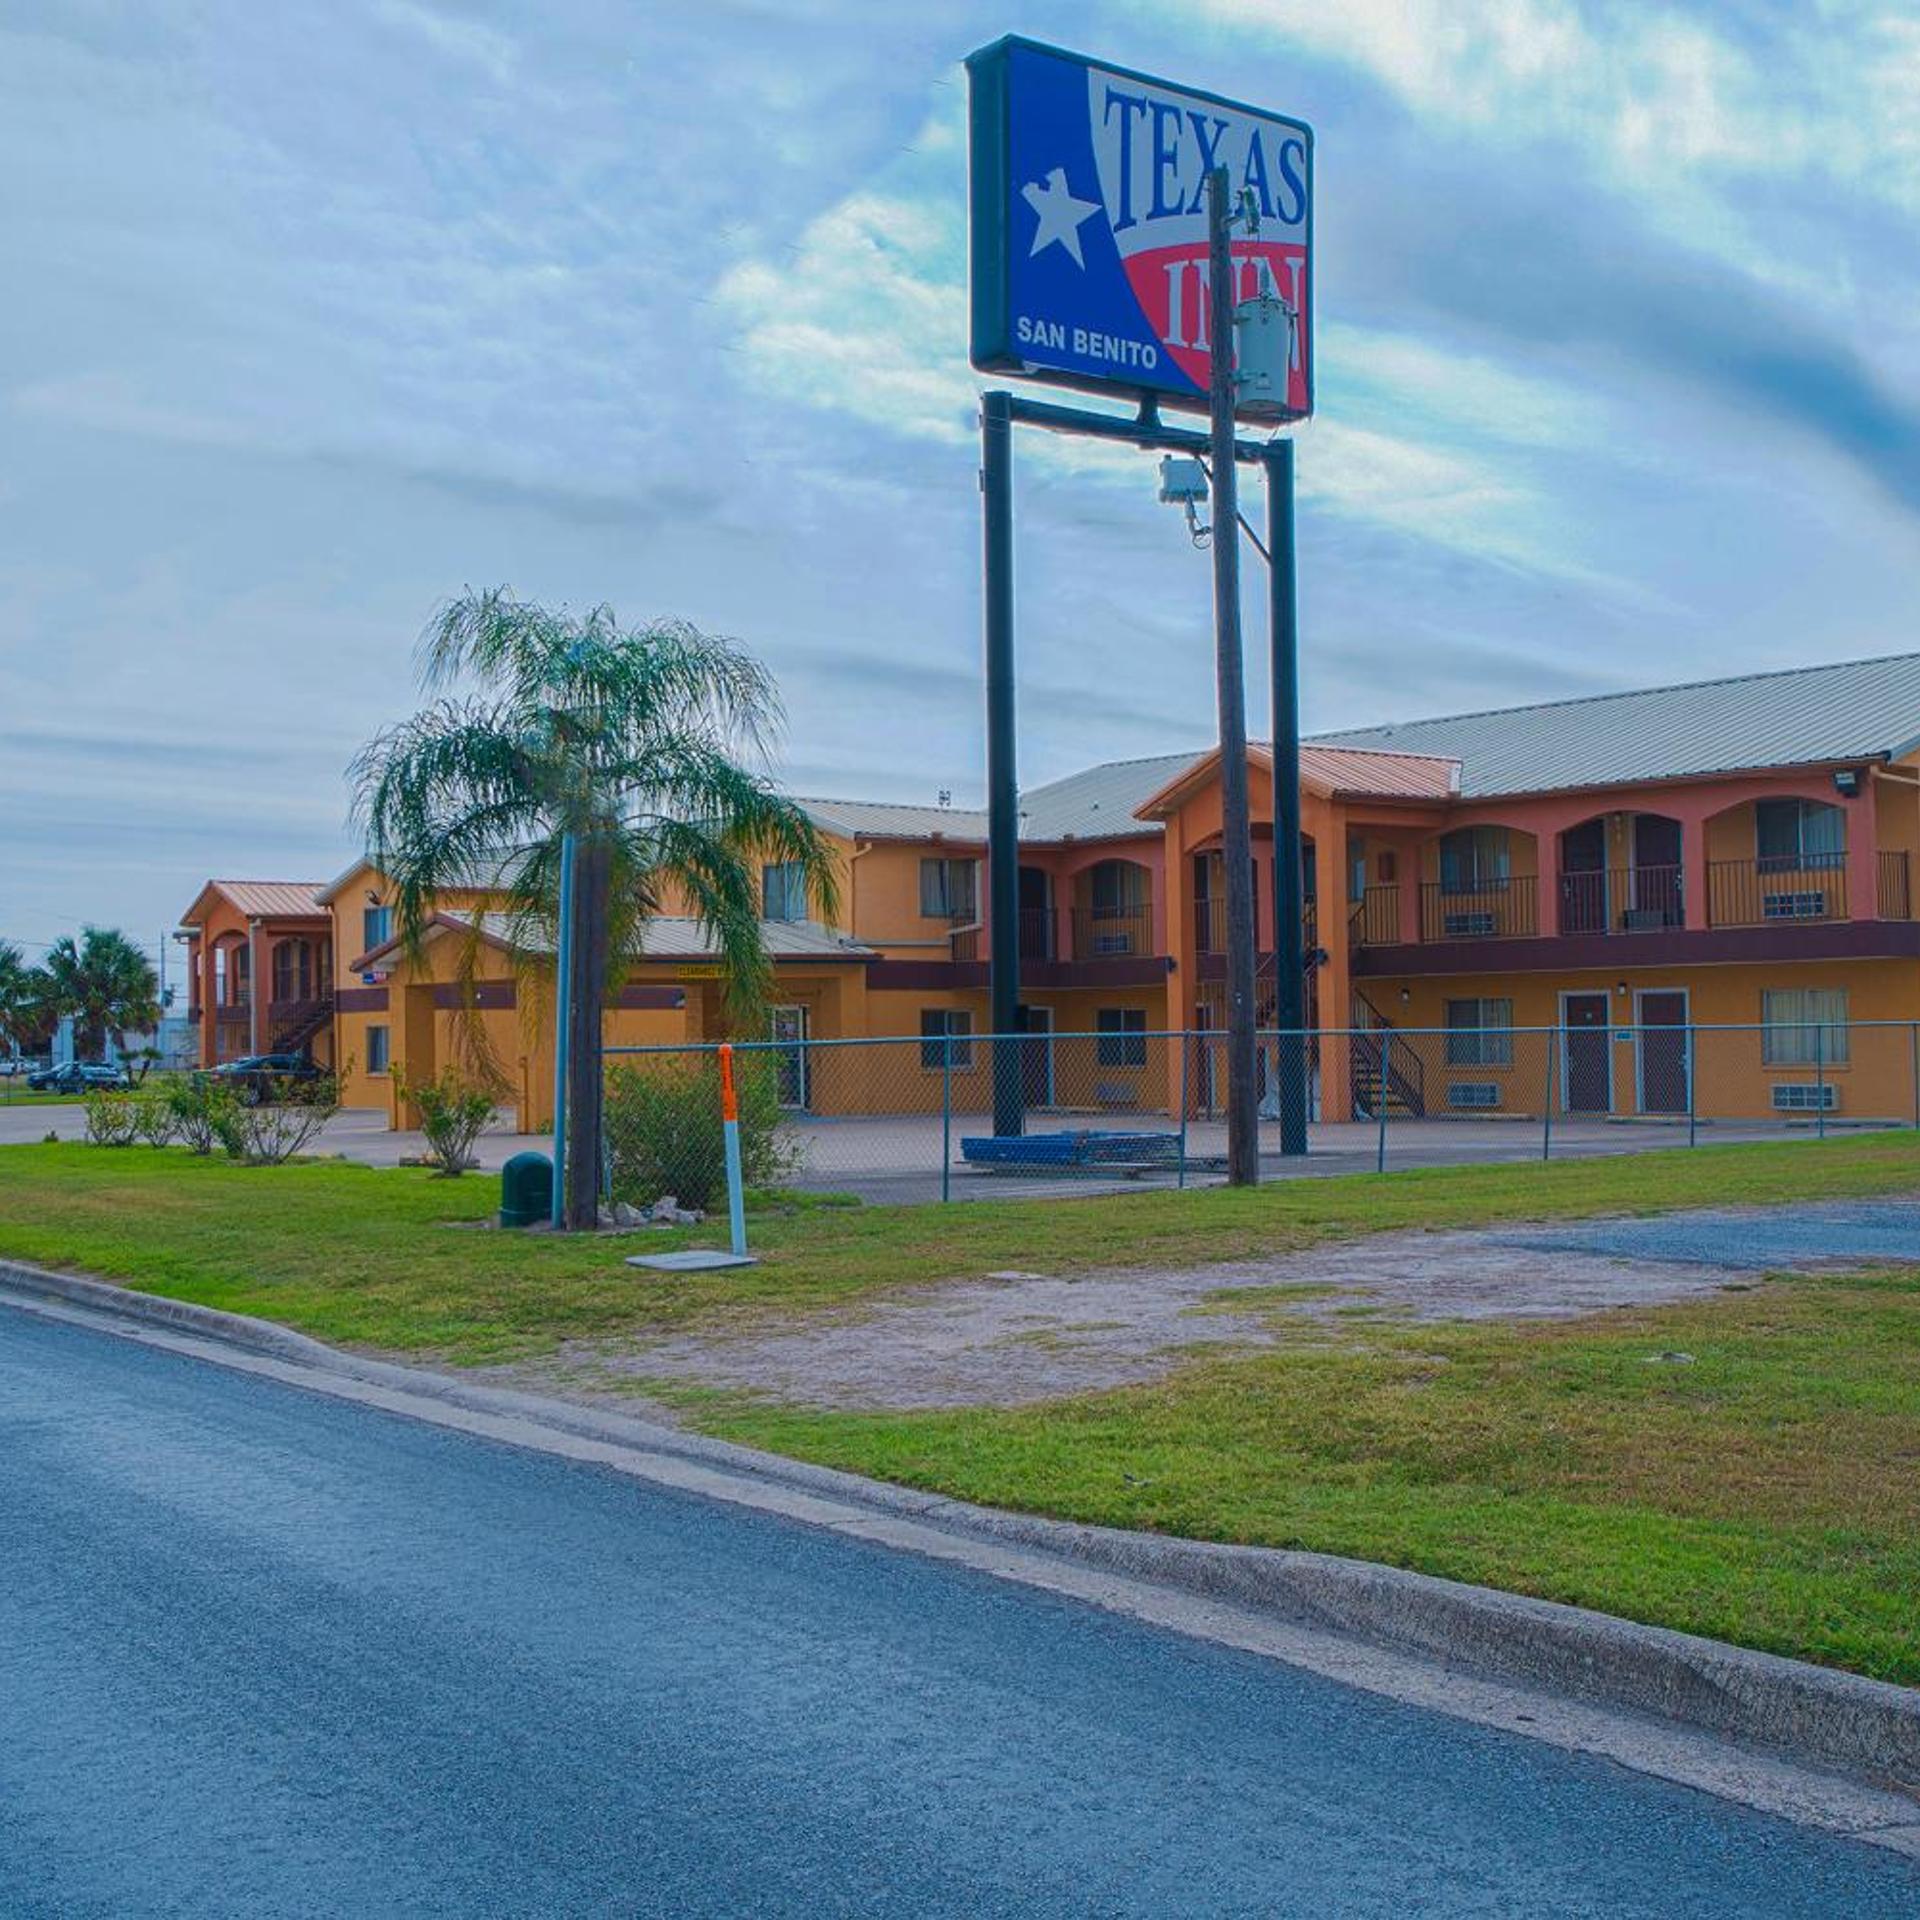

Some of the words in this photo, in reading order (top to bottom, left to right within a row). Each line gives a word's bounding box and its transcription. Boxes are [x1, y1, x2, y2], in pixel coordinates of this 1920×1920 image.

[1104, 86, 1305, 232] TEXAS
[1017, 316, 1065, 350] SAN
[1073, 328, 1157, 369] BENITO
